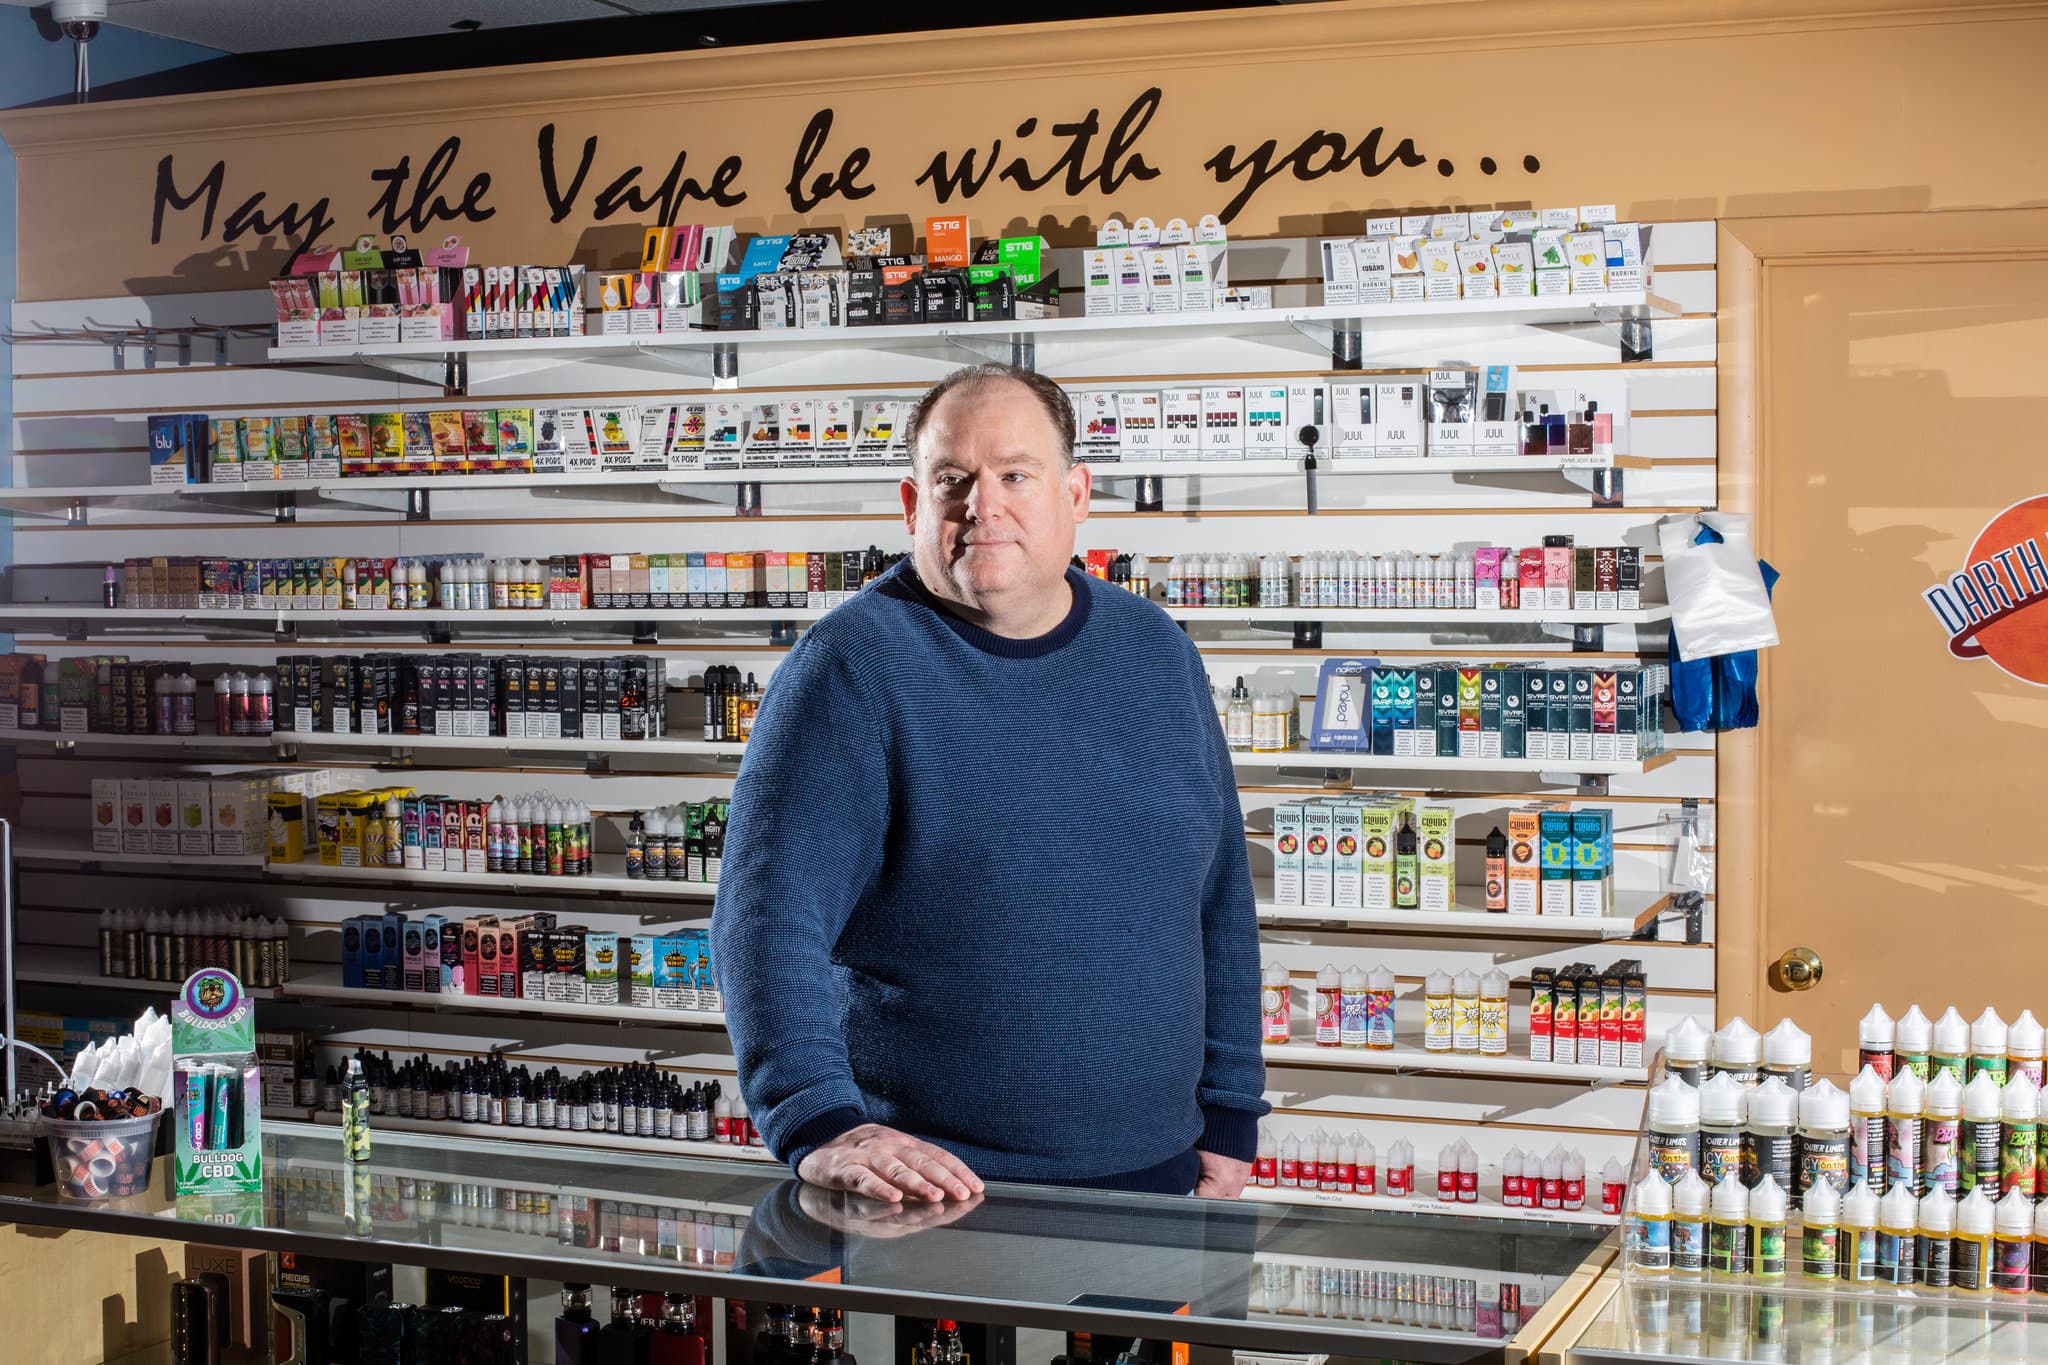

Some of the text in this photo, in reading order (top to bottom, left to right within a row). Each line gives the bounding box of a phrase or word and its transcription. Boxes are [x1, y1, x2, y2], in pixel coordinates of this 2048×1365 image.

[151, 154, 335, 276] May
[367, 136, 497, 235] the
[537, 122, 747, 227] Vape
[785, 108, 876, 213] be
[915, 87, 1162, 204] with
[933, 221, 960, 230] STIG
[1372, 221, 1395, 231] MYLÉ
[756, 238, 783, 246] STIG
[1005, 241, 1033, 251] STIG
[878, 257, 905, 266] STIG
[934, 254, 963, 263] MANGO
[851, 272, 873, 280] STIG
[886, 271, 908, 279] STIG
[971, 270, 994, 278] STIG
[1014, 274, 1035, 284] PPLE
[719, 277, 741, 285] STIG
[924, 277, 946, 285] STIG
[1435, 372, 1452, 380] JUUL
[1256, 432, 1275, 442] JUUL
[1344, 431, 1363, 441] JUUL
[1386, 430, 1406, 440] JUUL
[1440, 429, 1459, 439] JUUL
[1484, 428, 1504, 438] JUUL
[155, 435, 172, 449] blu
[1132, 434, 1150, 444] JUUL
[1173, 434, 1191, 444] JUUL
[1213, 434, 1231, 443] JUUL
[535, 457, 547, 465] 4X
[569, 458, 596, 466] 4X PODS
[1923, 538, 2048, 635] DARTH
[1336, 683, 1351, 722] naked
[728, 698, 737, 734] FRYD
[1276, 814, 1300, 823] CLOUDS
[1306, 814, 1330, 824] CLOUDS
[1334, 815, 1359, 824] CLOUDS
[1363, 815, 1389, 825] CLOUDS
[1421, 817, 1447, 827] CLOUDS
[1509, 821, 1535, 830] CLOUDS
[1543, 822, 1568, 831] CLOUDS
[1574, 822, 1600, 832] CLOUDS
[553, 948, 577, 956] CANDY
[177, 1006, 247, 1030] BULLDOG CBD
[193, 1153, 243, 1164] BULLDOG
[1703, 1150, 1722, 1163] ICY
[1802, 1157, 1818, 1169] ICY
[202, 1164, 235, 1178] CBD
[191, 1255, 236, 1274] LUXE
[281, 1272, 310, 1283] AEGIS
